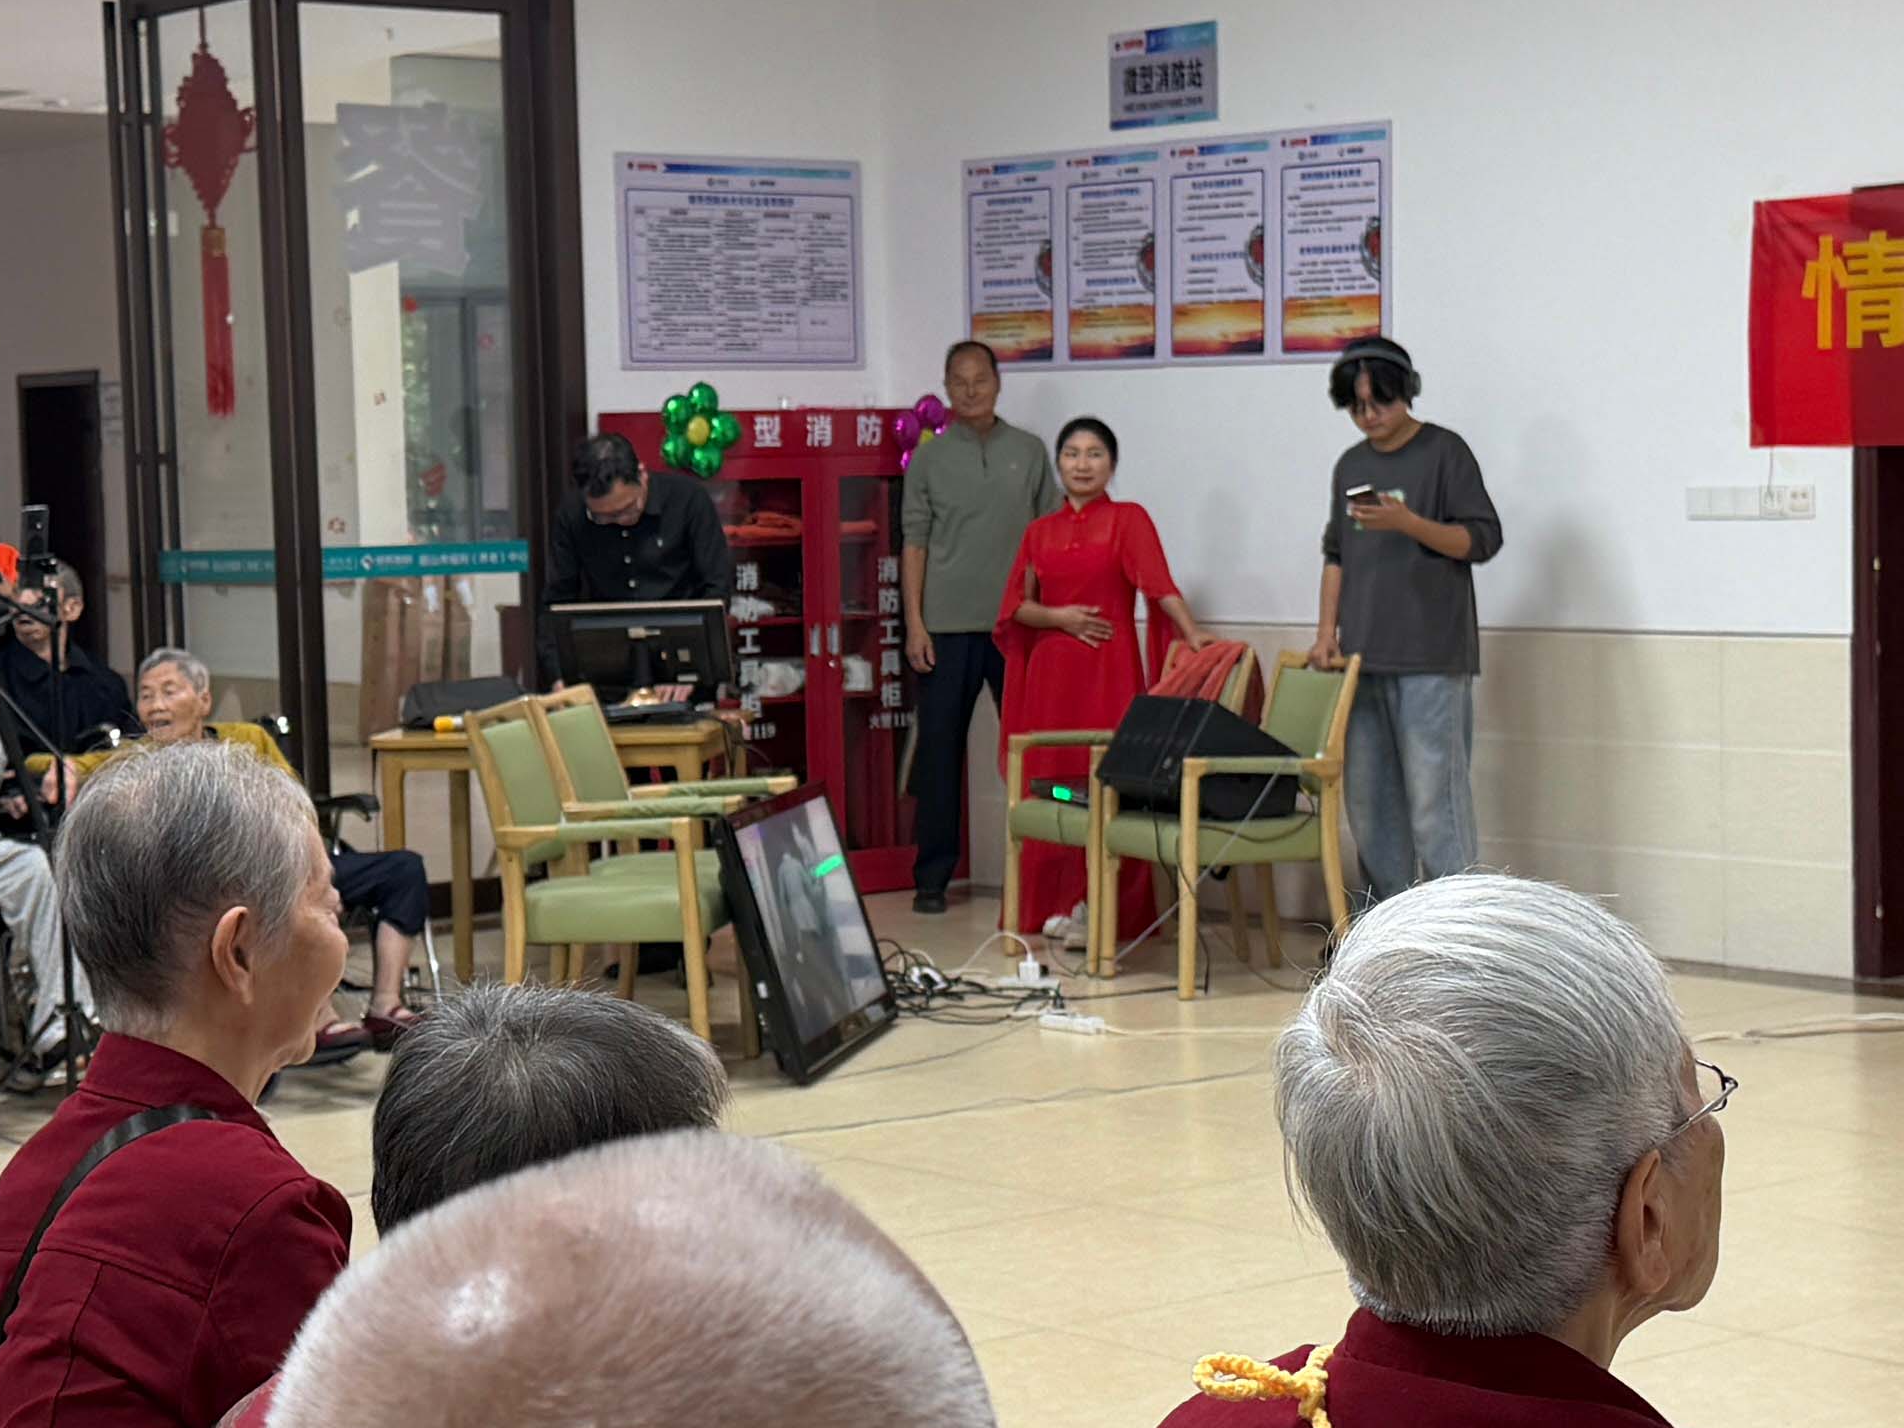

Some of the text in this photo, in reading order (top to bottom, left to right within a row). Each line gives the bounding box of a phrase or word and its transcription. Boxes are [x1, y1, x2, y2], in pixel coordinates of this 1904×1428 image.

[877, 556, 902, 708] 消防工具柜
